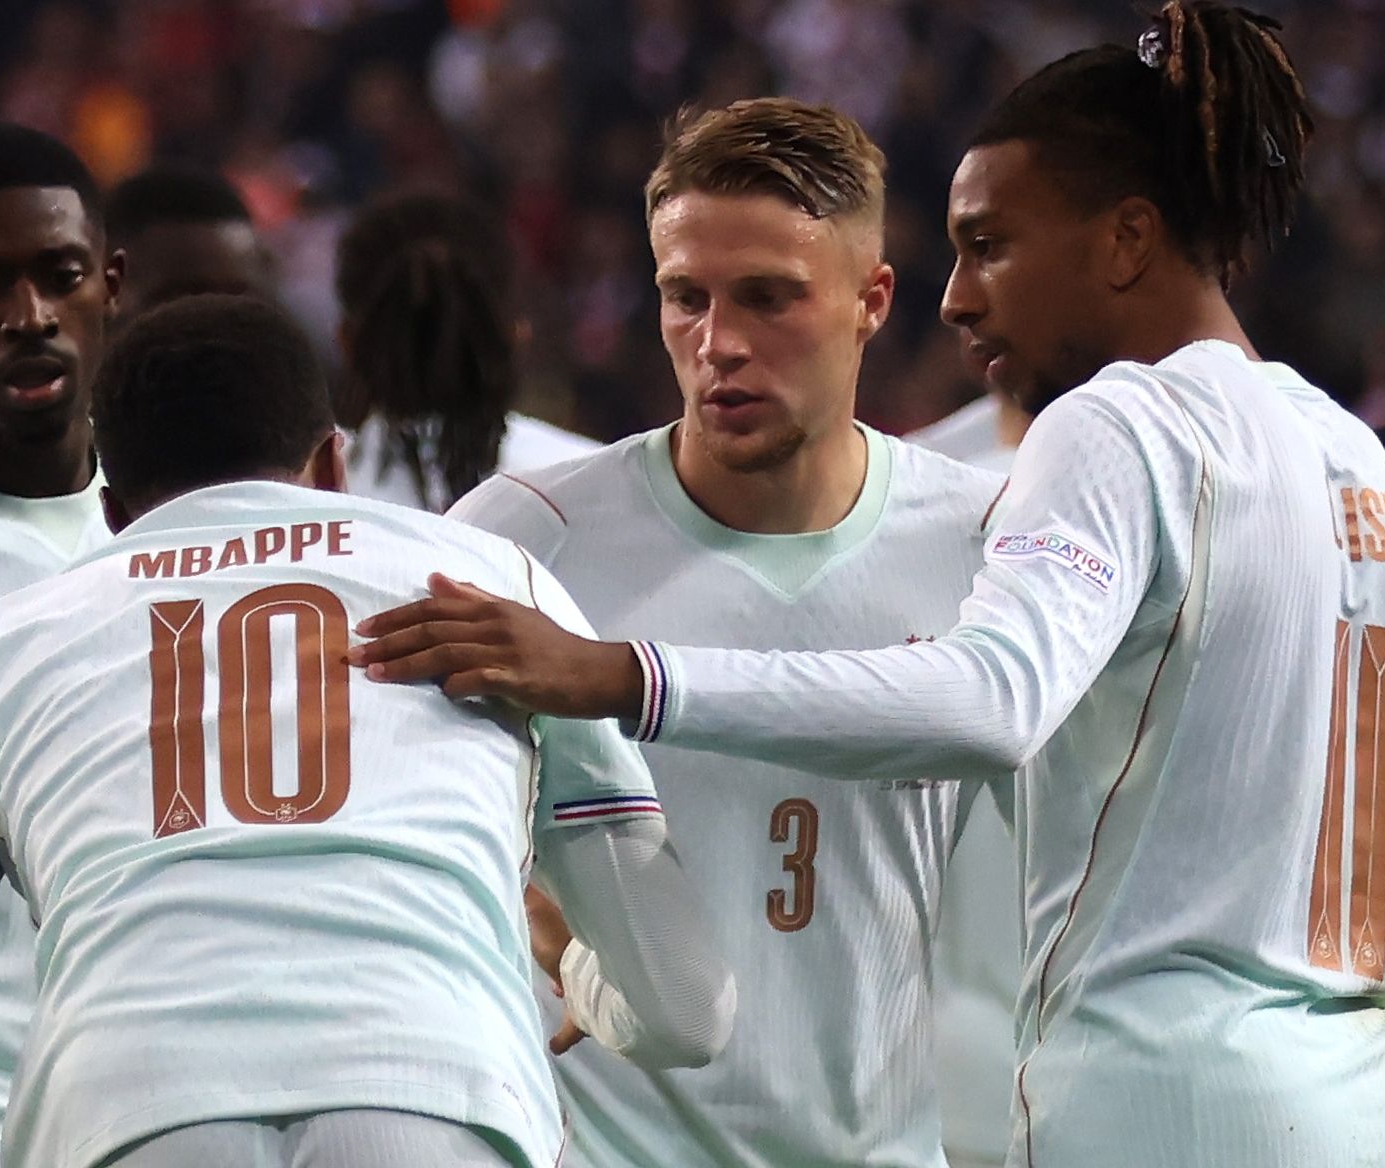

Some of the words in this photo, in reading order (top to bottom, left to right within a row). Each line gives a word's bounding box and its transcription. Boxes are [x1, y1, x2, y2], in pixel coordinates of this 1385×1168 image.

[128, 520, 353, 579] MBAPPE
[994, 533, 1115, 582] FOUNDATION
[150, 582, 351, 839] 10
[767, 798, 819, 932] 3
